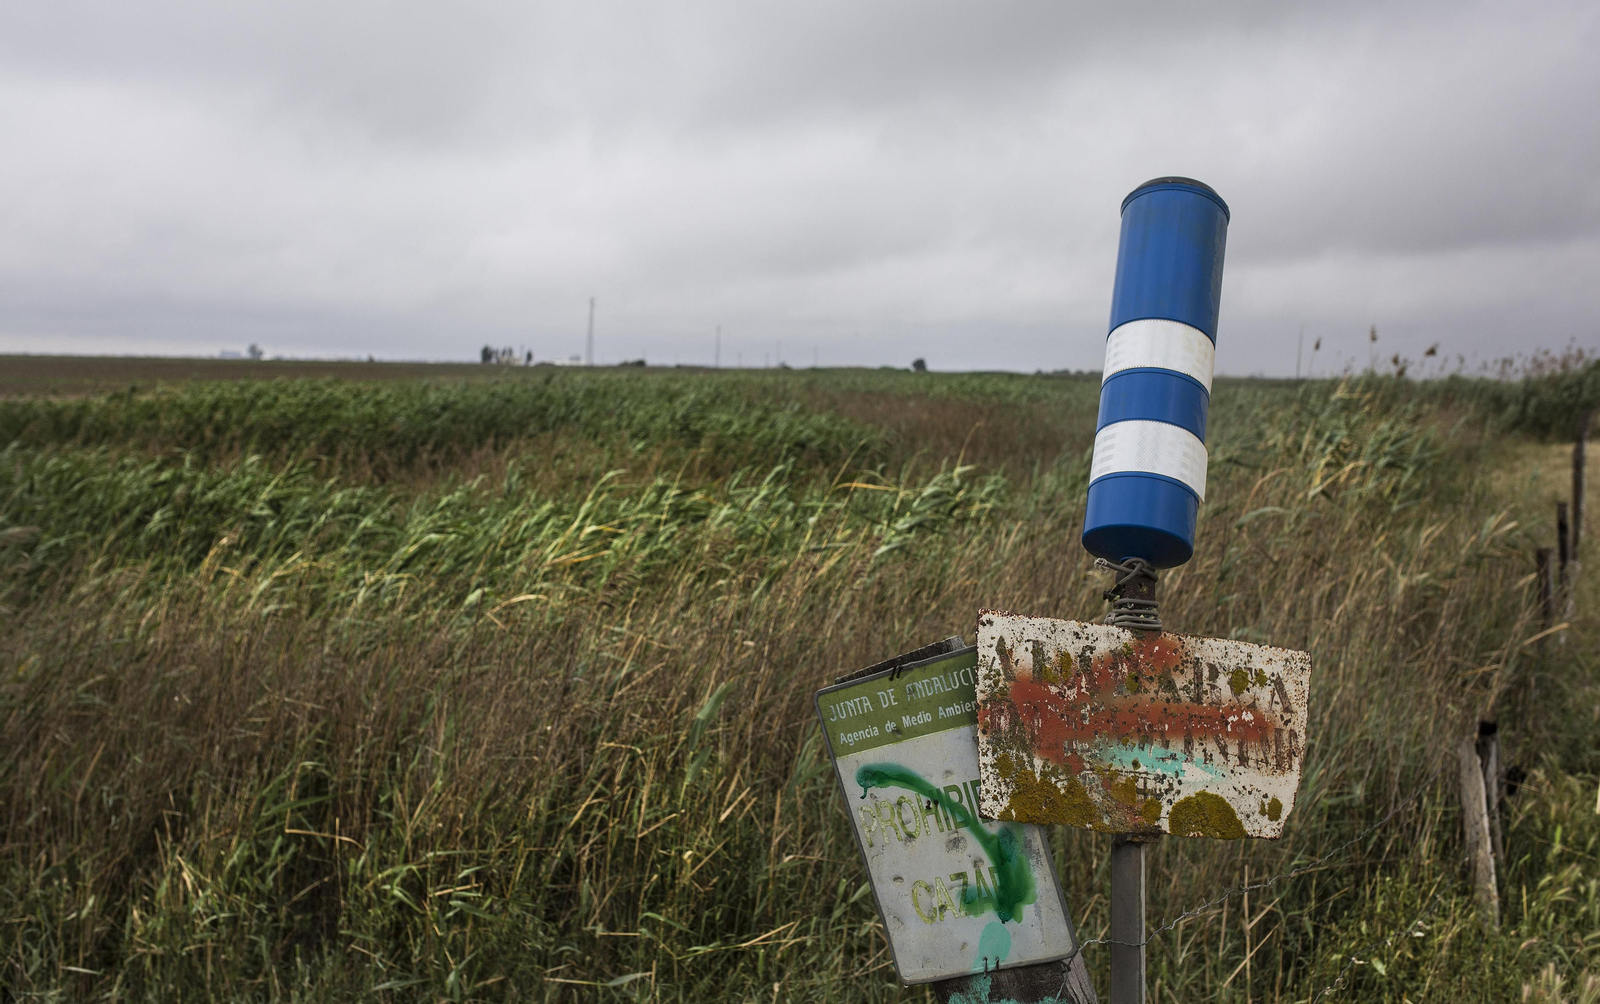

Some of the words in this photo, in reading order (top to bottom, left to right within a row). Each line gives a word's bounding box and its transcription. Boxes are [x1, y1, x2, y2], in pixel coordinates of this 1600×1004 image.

[829, 696, 873, 722] JUNTA
[877, 688, 899, 709] DE
[905, 666, 977, 702] ANDALUCI
[840, 725, 879, 746] Agencia
[885, 720, 897, 733] de
[902, 711, 932, 728] Medio
